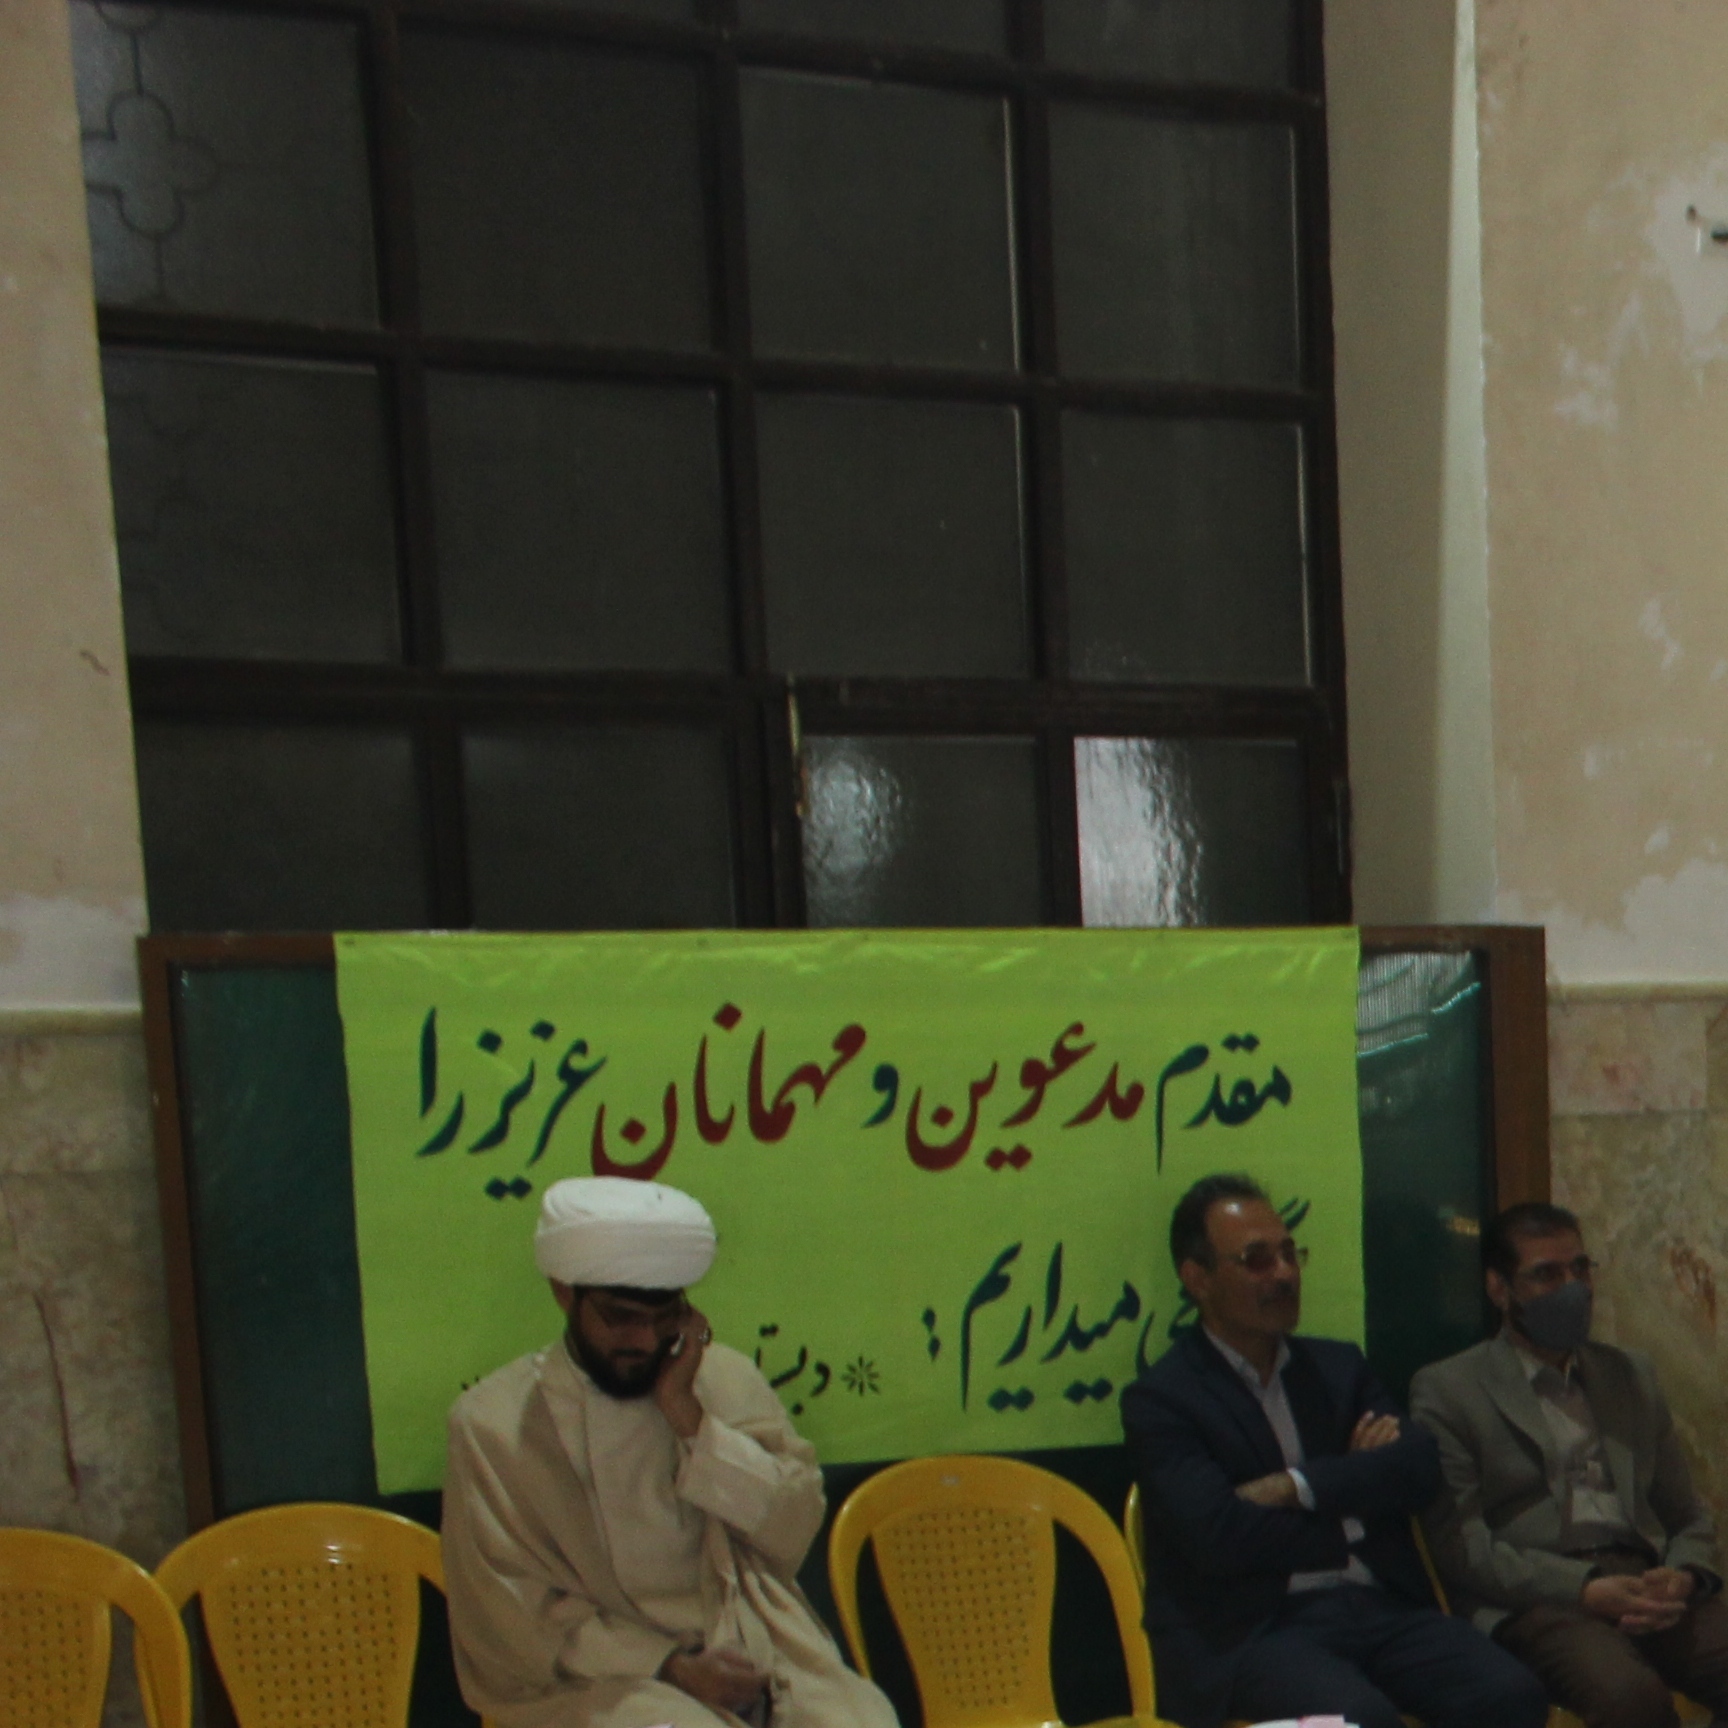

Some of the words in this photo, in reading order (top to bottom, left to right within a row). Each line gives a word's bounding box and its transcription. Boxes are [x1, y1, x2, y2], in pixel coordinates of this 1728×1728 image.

[415, 1006, 465, 1158] را
[469, 1020, 607, 1201] عزیز
[590, 1002, 867, 1182] مهمانان
[866, 1063, 900, 1128] و
[905, 1021, 1145, 1173] مدعوین
[1155, 1034, 1292, 1174] مقدم
